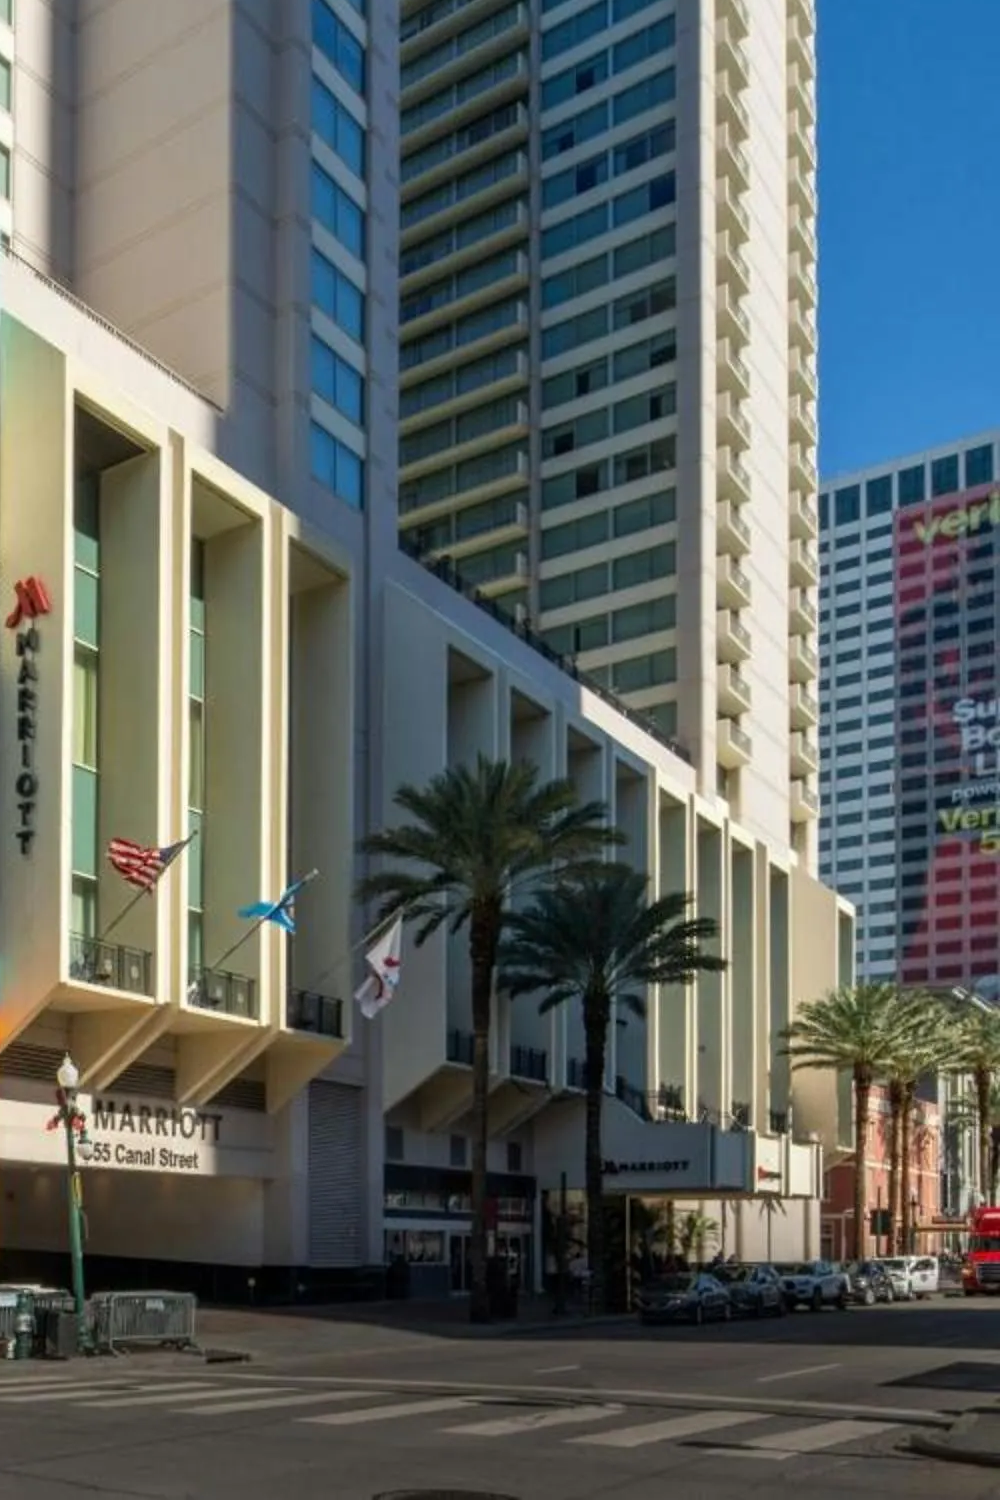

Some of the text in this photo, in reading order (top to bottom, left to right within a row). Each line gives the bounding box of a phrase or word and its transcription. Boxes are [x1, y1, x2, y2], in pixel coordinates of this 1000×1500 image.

[953, 698, 1000, 722] Su
[15, 627, 39, 856] MARRIOTT
[93, 1101, 222, 1141] MARRIOTT
[115, 1144, 154, 1166] Canal
[159, 1148, 199, 1169] Street
